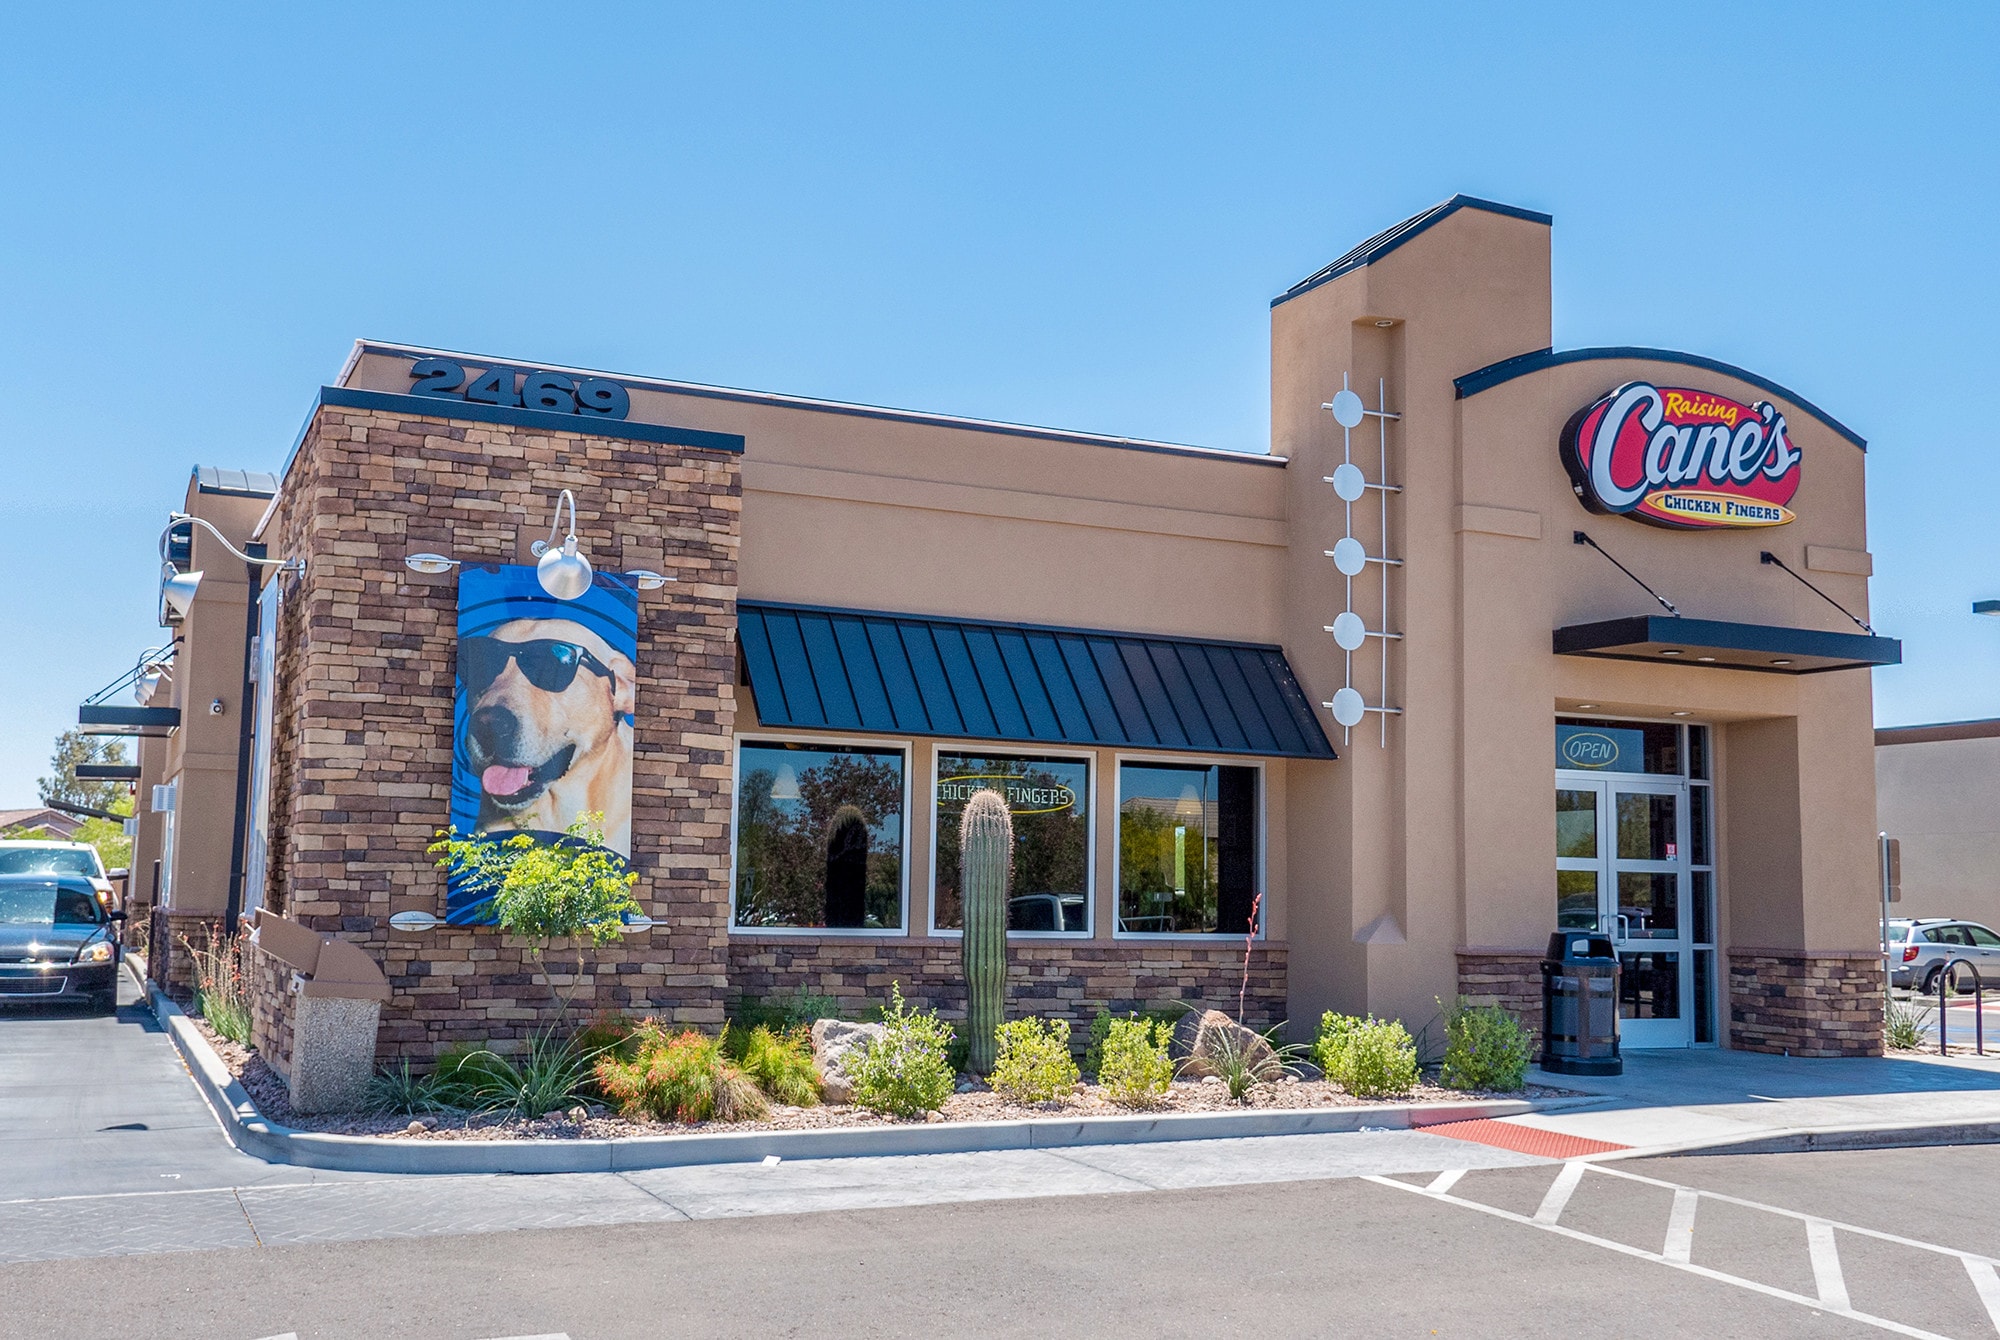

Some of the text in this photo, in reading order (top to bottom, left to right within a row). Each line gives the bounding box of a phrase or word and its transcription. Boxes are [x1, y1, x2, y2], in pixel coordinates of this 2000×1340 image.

[409, 358, 631, 421] 2469
[1664, 392, 1738, 426] Raising
[1590, 383, 1801, 511] Cane's
[1664, 494, 1780, 520] CHICKEN FINGERS
[1570, 741, 1611, 759] OPEN
[937, 784, 1068, 805] HICK FINGERS
